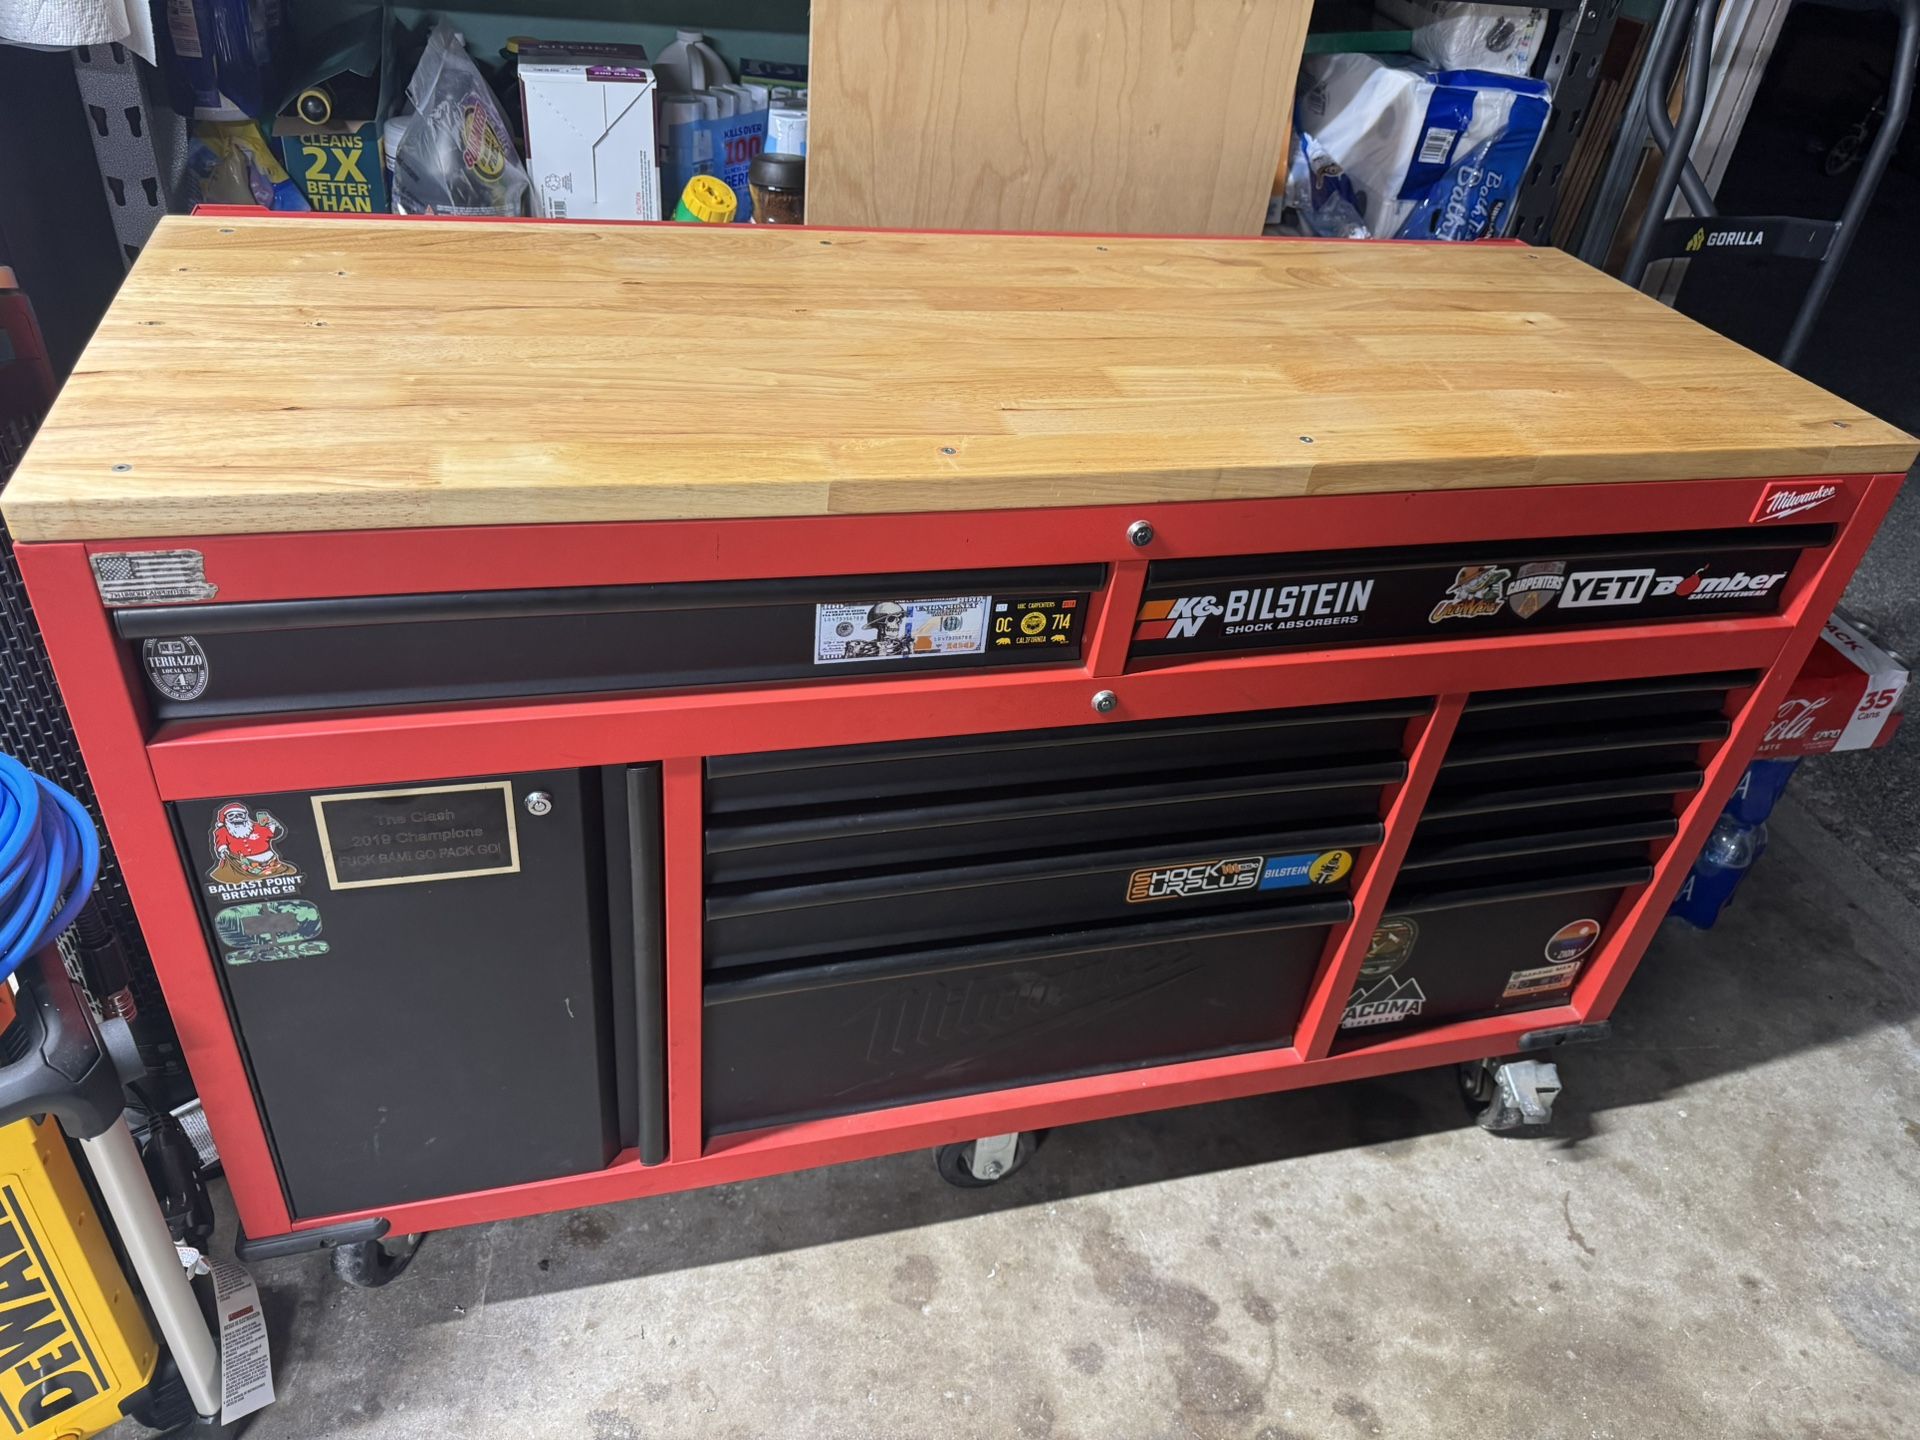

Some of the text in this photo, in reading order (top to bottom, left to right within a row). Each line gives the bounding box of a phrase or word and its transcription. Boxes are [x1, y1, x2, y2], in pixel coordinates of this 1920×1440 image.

[300, 134, 363, 148] CLEANS
[302, 146, 368, 183] 2X
[308, 194, 373, 213] THAN
[1706, 231, 1764, 246] GORILLA
[1766, 485, 1836, 513] Milwaukee
[1507, 576, 1565, 595] CARPENTERS
[1572, 575, 1648, 601] YETI
[1223, 579, 1375, 623] BILSTEIN
[1688, 592, 1722, 600] SAFETY
[995, 616, 1013, 633] OC
[1051, 613, 1072, 631] 714
[1225, 615, 1359, 635] SHOCK ABSORBERS
[1015, 635, 1047, 644] CALIFORNIA
[1825, 621, 1864, 651] ACK
[147, 654, 203, 669] TERRAZZO
[1858, 689, 1898, 713] 35
[1857, 711, 1881, 721] Cans
[375, 809, 456, 826] The Clash
[396, 827, 484, 844] Champions
[439, 846, 475, 858] PACK
[1134, 865, 1219, 885] SHOCK
[1264, 864, 1309, 879] BILSTEIN
[208, 874, 303, 895] BALLAST POINT
[221, 885, 296, 901] BREWING CO
[1132, 872, 1256, 899] SURPLUS
[1343, 1000, 1420, 1020] ACOMA
